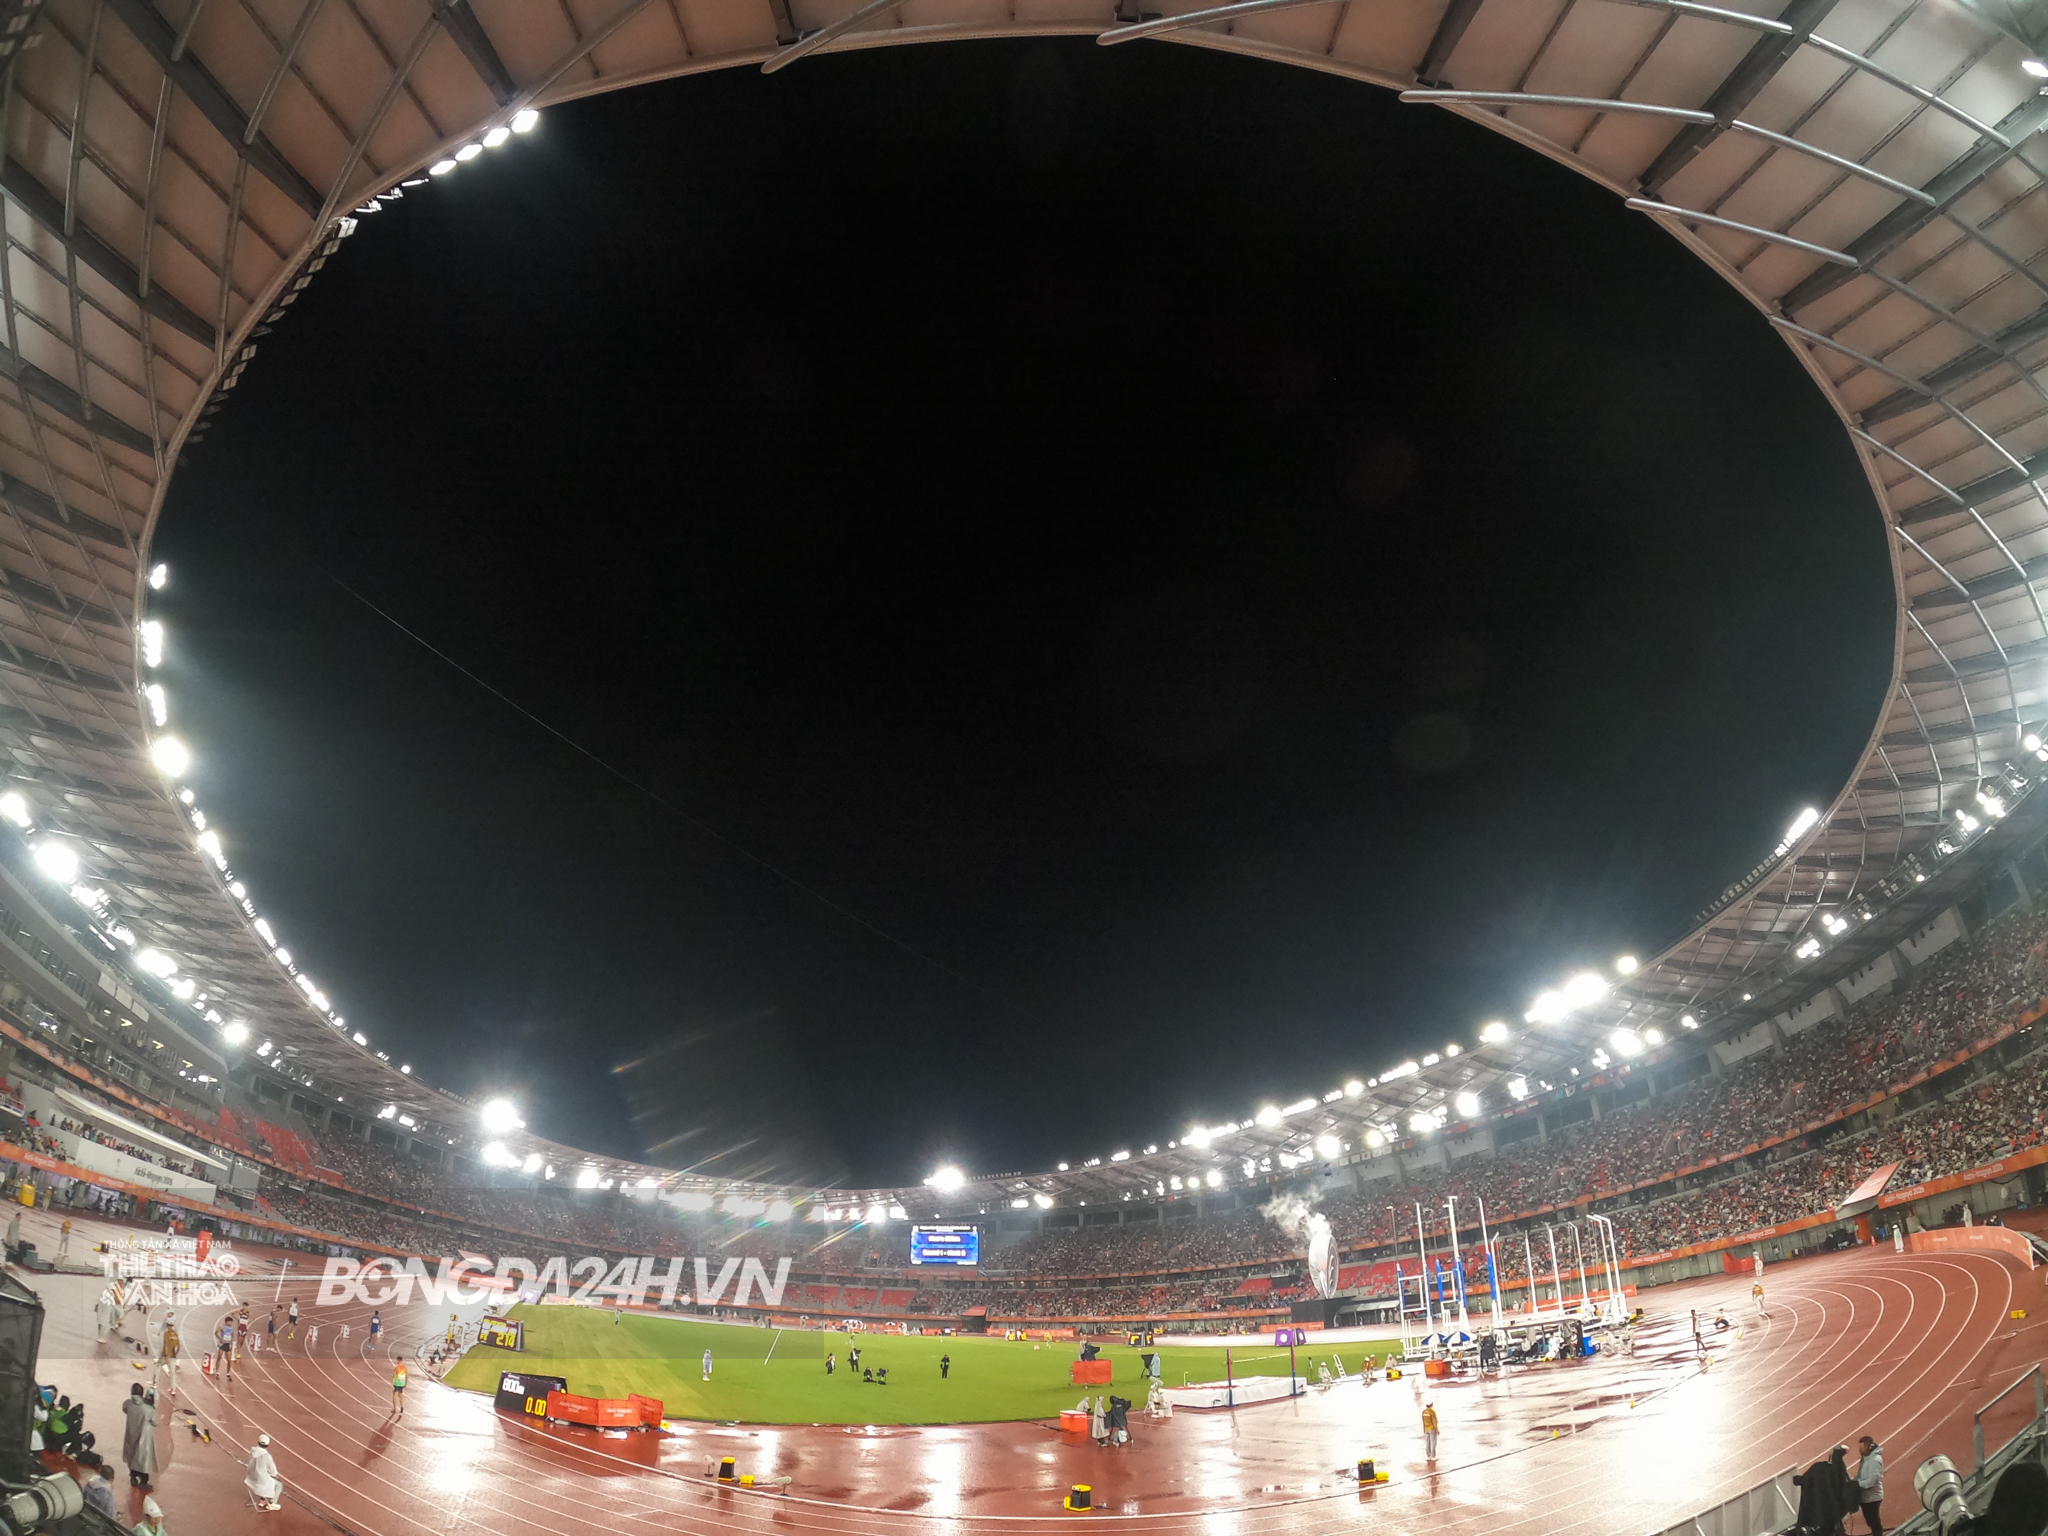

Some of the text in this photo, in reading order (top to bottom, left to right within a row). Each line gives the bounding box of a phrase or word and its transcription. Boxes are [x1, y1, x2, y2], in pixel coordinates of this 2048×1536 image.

[1913, 1186, 1925, 1196] 2026
[1764, 1229, 1776, 1237] 2026
[1661, 1252, 1673, 1260] 2026
[502, 1377, 525, 1395] 800m
[525, 1396, 547, 1416] 0.00
